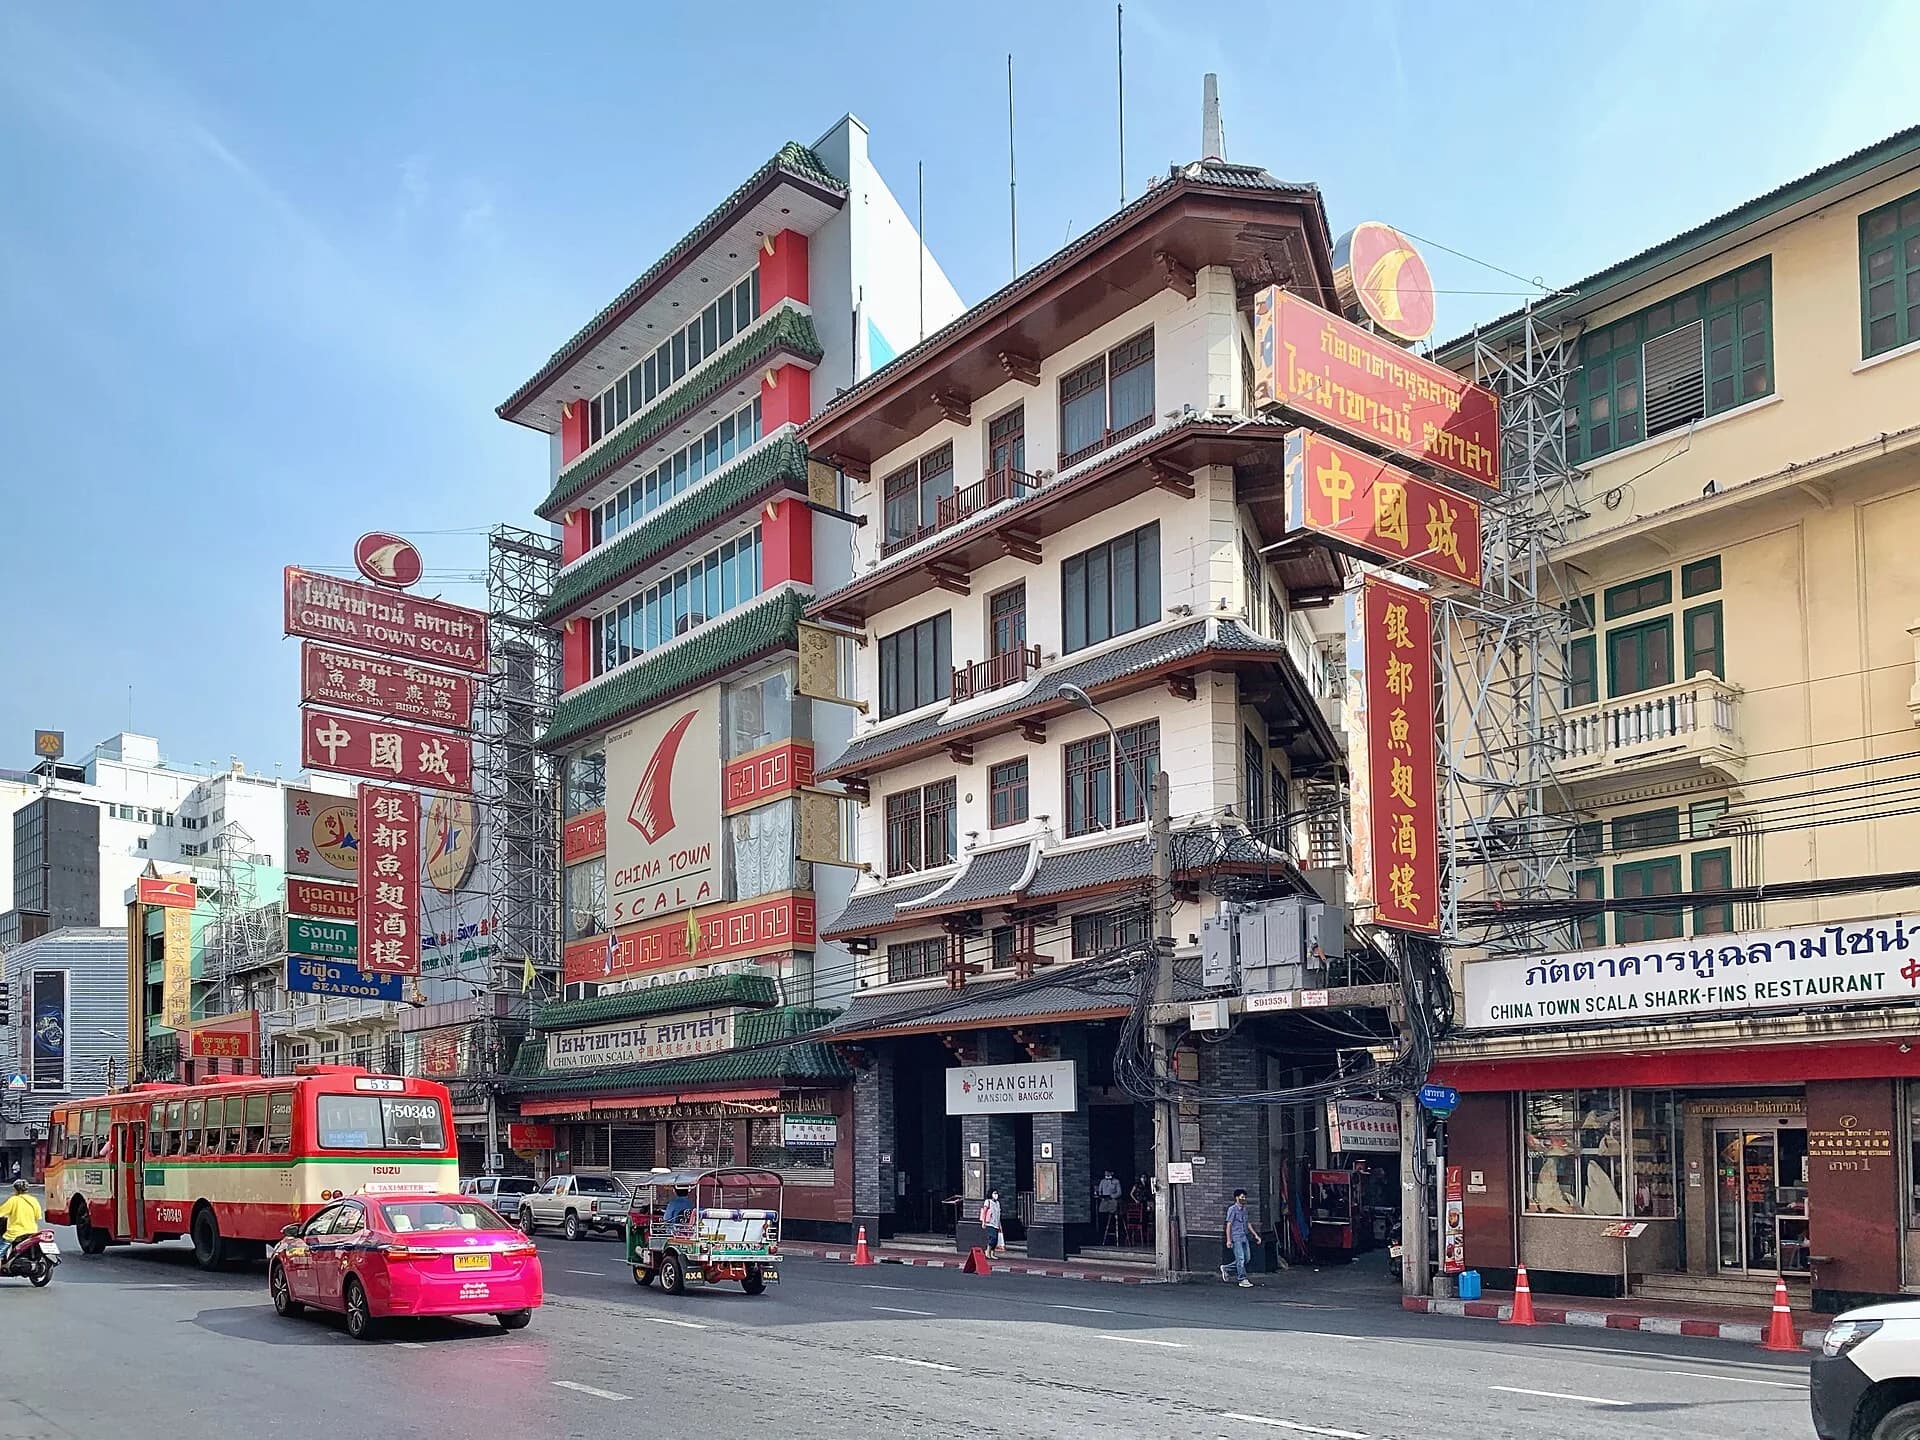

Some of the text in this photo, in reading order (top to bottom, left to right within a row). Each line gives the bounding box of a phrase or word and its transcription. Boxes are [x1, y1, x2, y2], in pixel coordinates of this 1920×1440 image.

[1316, 451, 1467, 573] 中國城
[300, 610, 477, 661] CHINA TOWN SCALA
[318, 687, 457, 721] SHARK'S FIN BIRD'S NEST
[315, 719, 456, 785] 中國城
[1382, 601, 1421, 915] 銀都魚翅酒樓
[324, 852, 345, 862] NAM
[614, 843, 711, 888] CHINA TOWN
[369, 797, 410, 968] 銀都魚翅酒樓
[310, 903, 356, 916] SHARK
[614, 881, 710, 921] SCALA
[298, 922, 347, 941] รังนก
[310, 941, 344, 953] BIRD
[312, 982, 380, 996] SEAFOOD
[1490, 972, 1885, 1020] CHINA TOWN SCALA SHARK-FINS RESTAURANT
[553, 1050, 634, 1067] CHINA TOWN SCALA
[977, 1074, 1054, 1092] SHANGHAI
[977, 1091, 1054, 1103] MANSION BANGKOK
[1449, 1092, 1456, 1104] 2
[382, 1103, 436, 1119] 7-50349
[373, 1166, 400, 1175] ISUZU
[1829, 1158, 1871, 1171] สาขา 1
[685, 1272, 702, 1280] 4X4
[763, 1271, 778, 1279] 4X4
